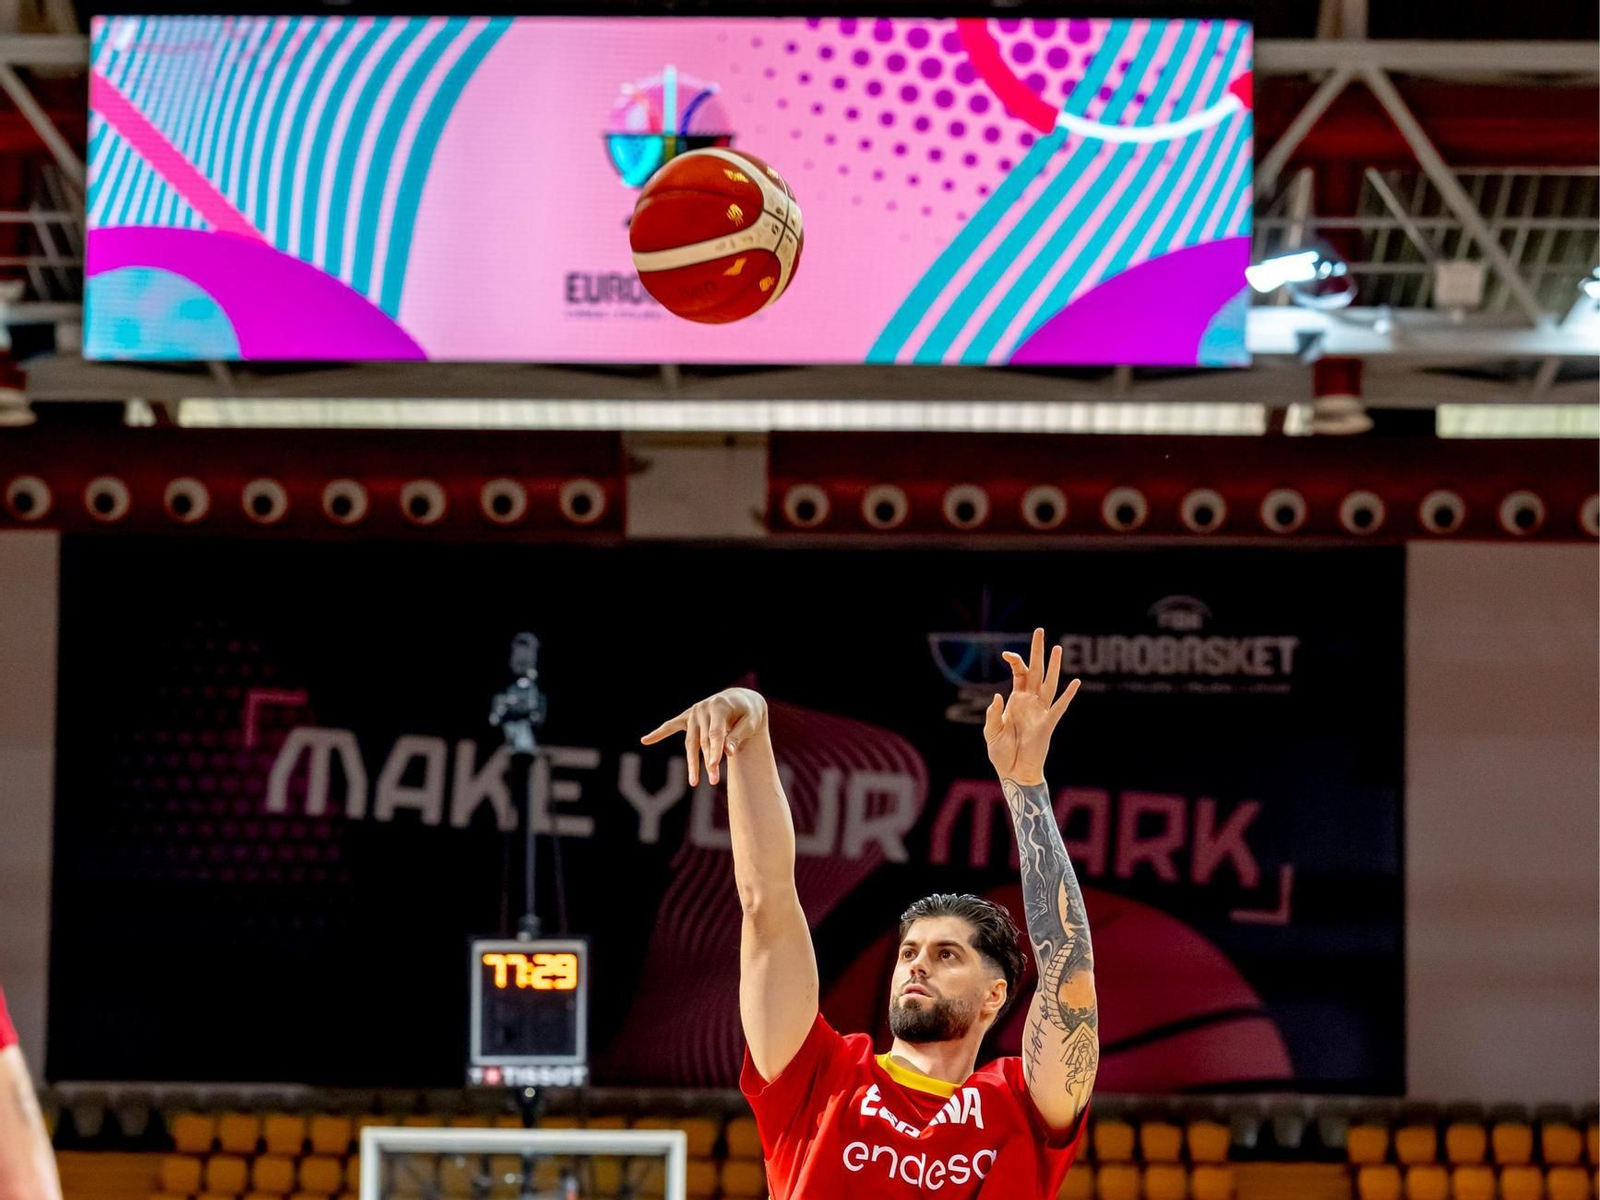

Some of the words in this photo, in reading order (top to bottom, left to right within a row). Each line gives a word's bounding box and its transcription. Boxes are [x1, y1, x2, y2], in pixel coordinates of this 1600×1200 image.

[1060, 634, 1299, 676] EUROBASKET
[266, 727, 600, 838] MAKE
[842, 1141, 998, 1191] endesa
